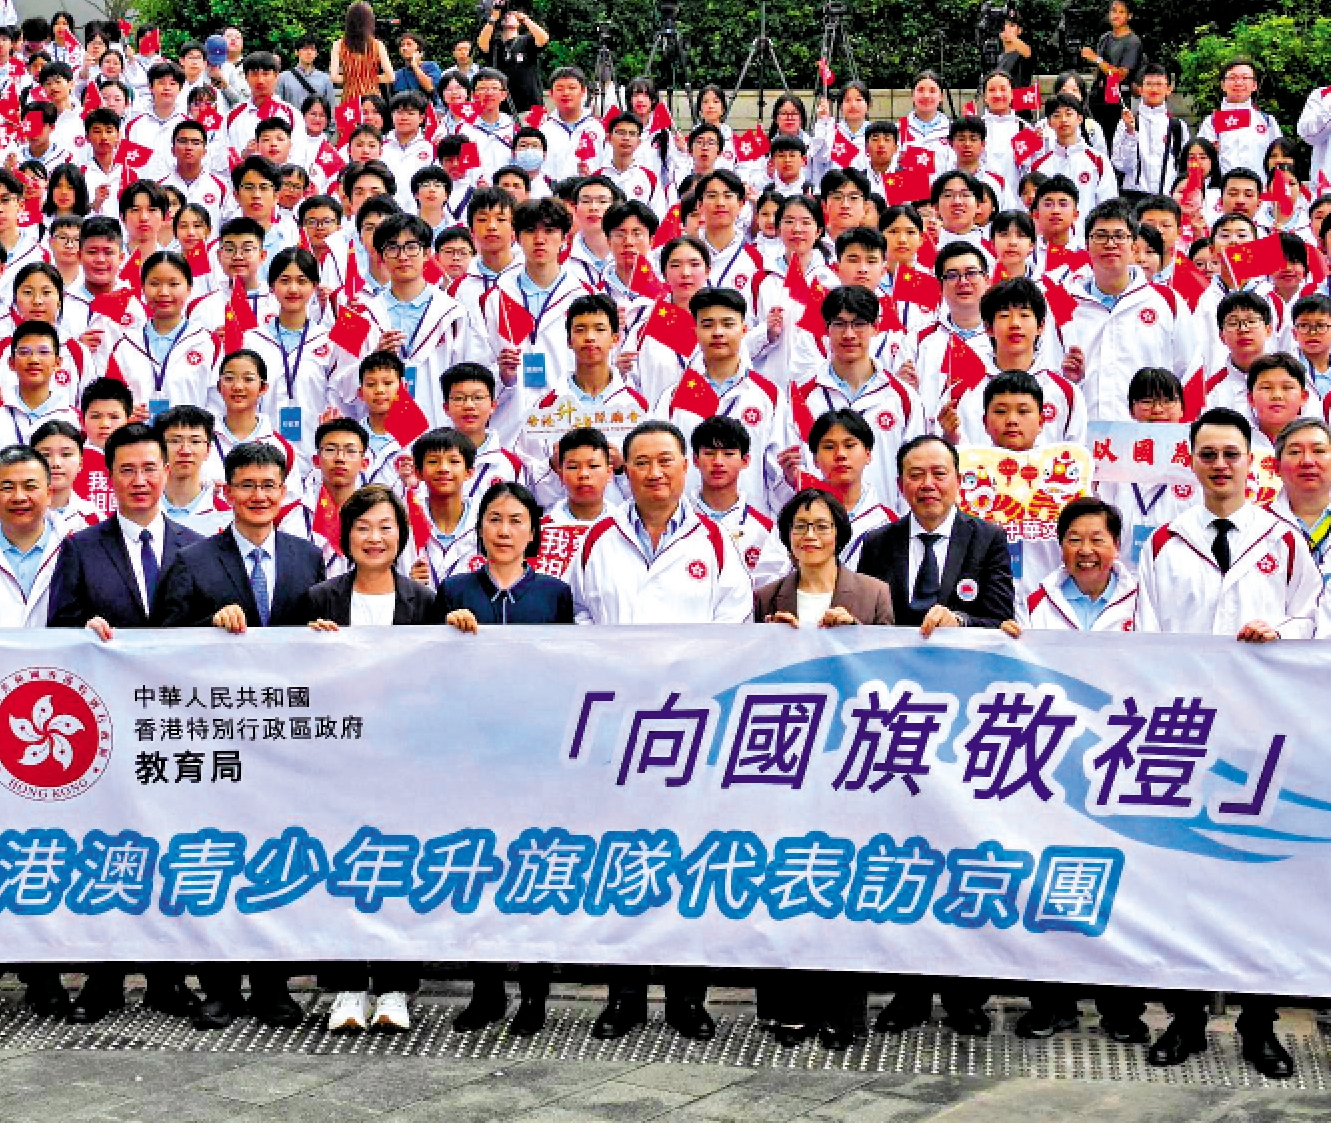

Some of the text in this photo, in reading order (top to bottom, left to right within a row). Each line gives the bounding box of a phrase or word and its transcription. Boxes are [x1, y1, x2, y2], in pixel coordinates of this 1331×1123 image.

[134, 685, 311, 709] 中華人民共和國
[134, 715, 365, 742] 香港特別行政區政府
[134, 750, 244, 784] 教育局
[568, 690, 1288, 817] 「向國旗敬禮」
